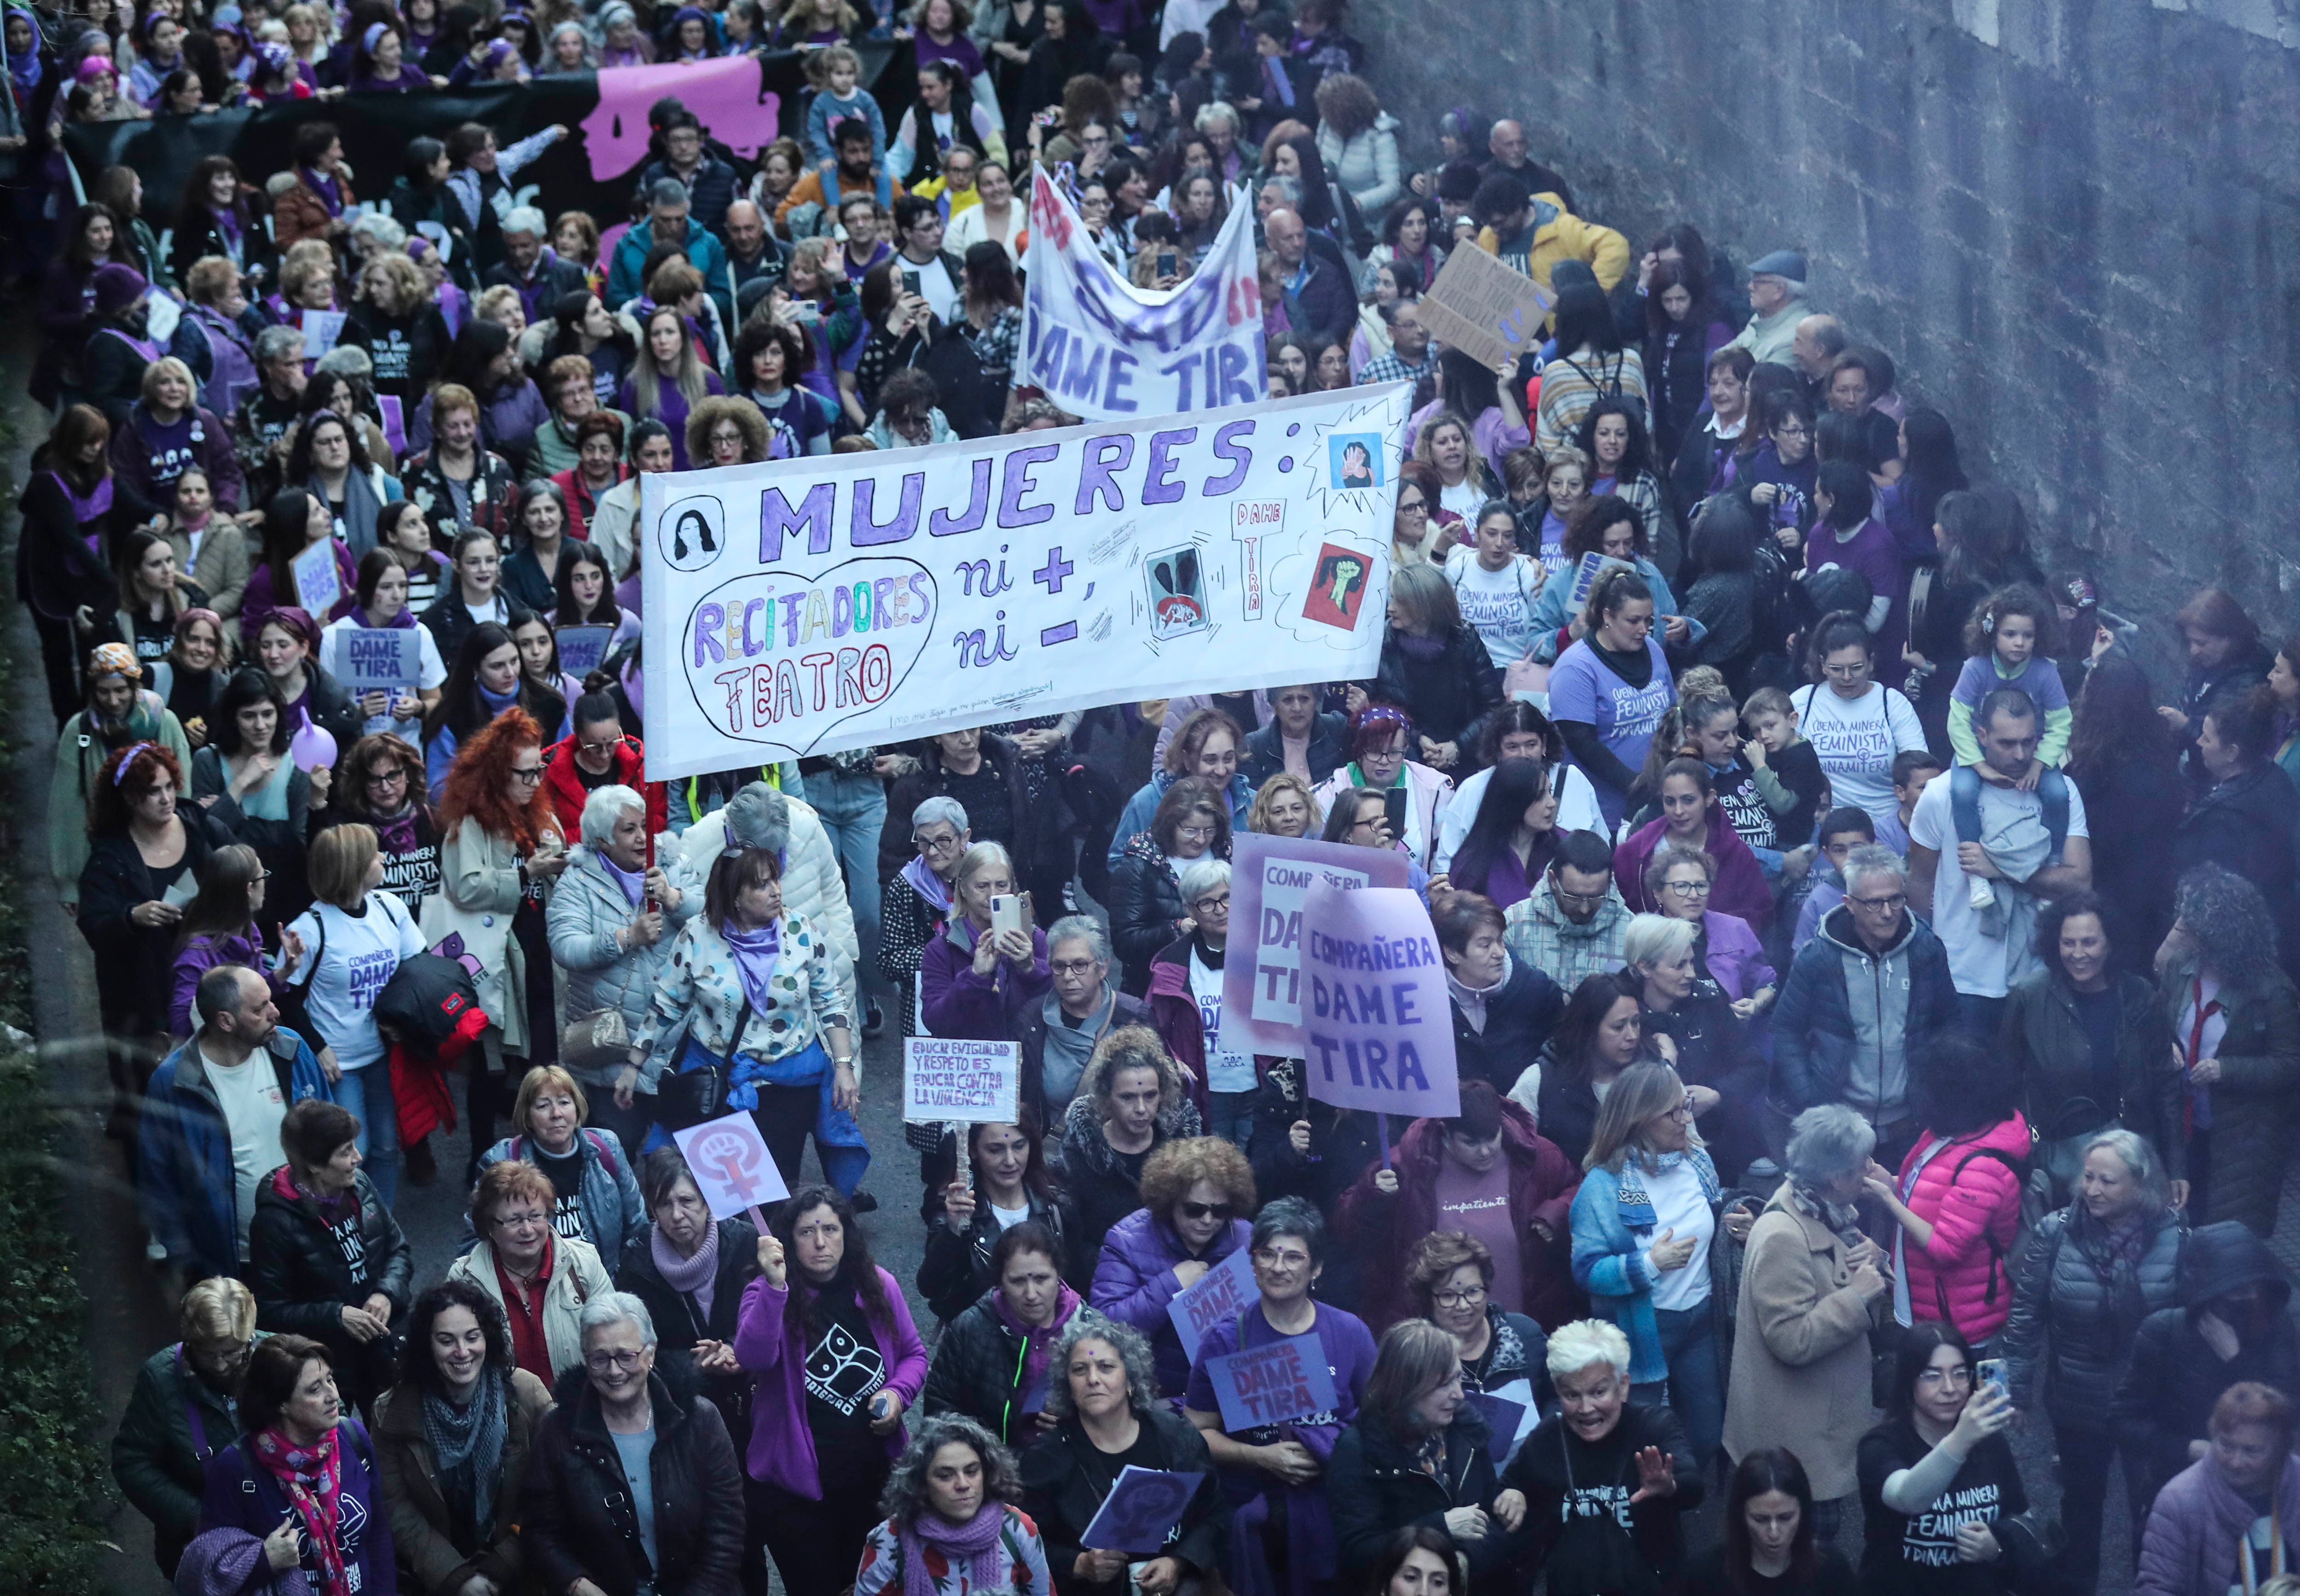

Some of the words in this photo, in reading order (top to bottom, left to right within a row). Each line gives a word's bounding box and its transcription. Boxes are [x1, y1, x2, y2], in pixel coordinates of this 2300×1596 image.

[1541, 544, 1561, 555] ENCA
[954, 544, 1014, 598] ni
[350, 640, 401, 658] DAME
[953, 610, 1020, 669] ni
[351, 659, 402, 677] TIRA
[713, 643, 892, 734] TEATRO
[1813, 720, 1845, 733] CUENCA
[1811, 733, 1889, 752] FEMINISTA
[399, 845, 437, 863] MINERA
[379, 861, 440, 886] MINISTA
[1266, 866, 1362, 890] COMPÑERA
[1262, 907, 1300, 949] DA
[349, 948, 395, 968] COMPAÑERA
[1311, 930, 1436, 971] COMPAÑERA
[350, 960, 396, 989] DAME
[1259, 964, 1299, 1005] TI
[350, 985, 383, 1009] TI
[1311, 973, 1422, 1025] DAME
[913, 1041, 949, 1054] EDUCAR
[913, 1055, 922, 1071] Y
[924, 1055, 969, 1071] RESPETO
[973, 1058, 992, 1070] ES
[1310, 1035, 1431, 1091] TIRA
[914, 1073, 955, 1087] EDUCAR
[957, 1071, 1002, 1089] CONTRA
[915, 1088, 929, 1104] LA
[931, 1088, 995, 1105] VIOLENCIA
[1442, 1196, 1506, 1214] impatiente
[1183, 1265, 1233, 1309] COMPAÑERA
[1187, 1278, 1245, 1333] DAME
[1230, 1355, 1308, 1398] DAME
[1241, 1385, 1317, 1421] TIRA
[1956, 1483, 1999, 1508] MINERA
